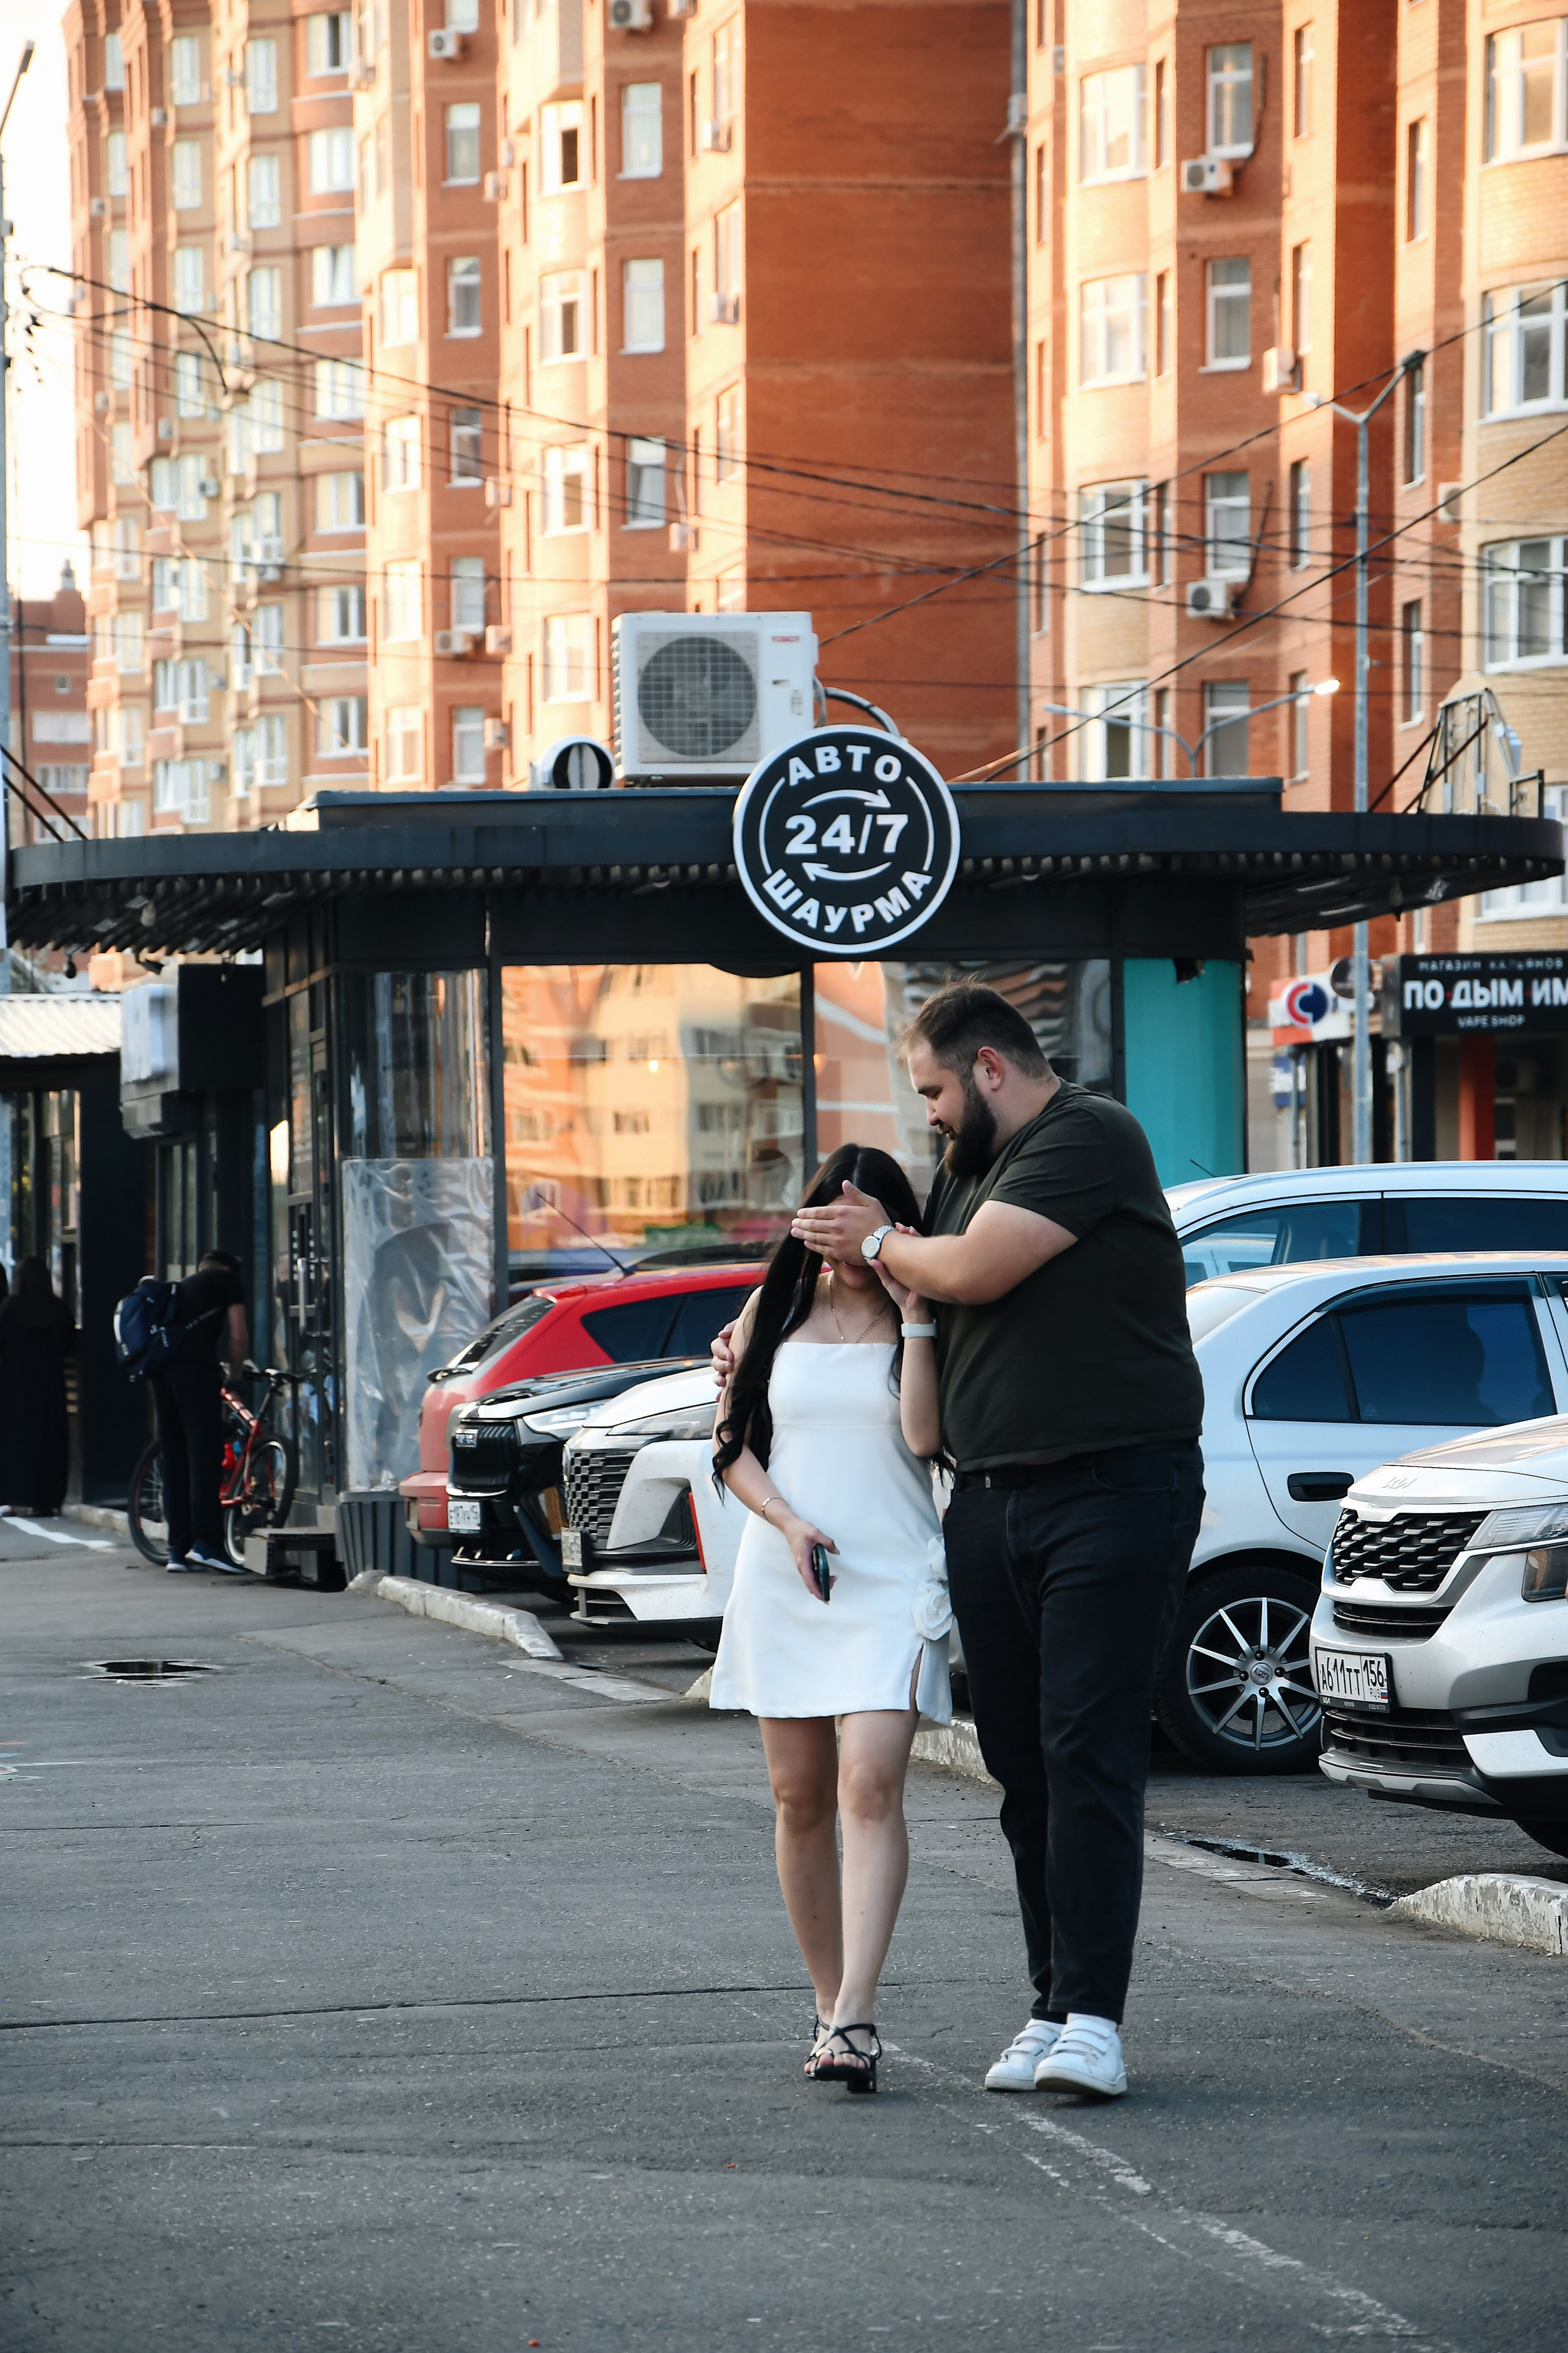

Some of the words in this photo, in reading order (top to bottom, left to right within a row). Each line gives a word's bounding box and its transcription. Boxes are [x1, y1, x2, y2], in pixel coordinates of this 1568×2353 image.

[788, 744, 902, 786] АВТО
[785, 814, 909, 855] 24/7
[762, 868, 933, 934] ШАУРМА
[1418, 959, 1482, 972] МАГАЗИН
[1404, 980, 1444, 1010] ПО
[1451, 978, 1524, 1009] ДЫМ
[1458, 1015, 1489, 1028] VAPE
[1491, 1014, 1525, 1027] SHOP
[1370, 1688, 1381, 1698] RUS
